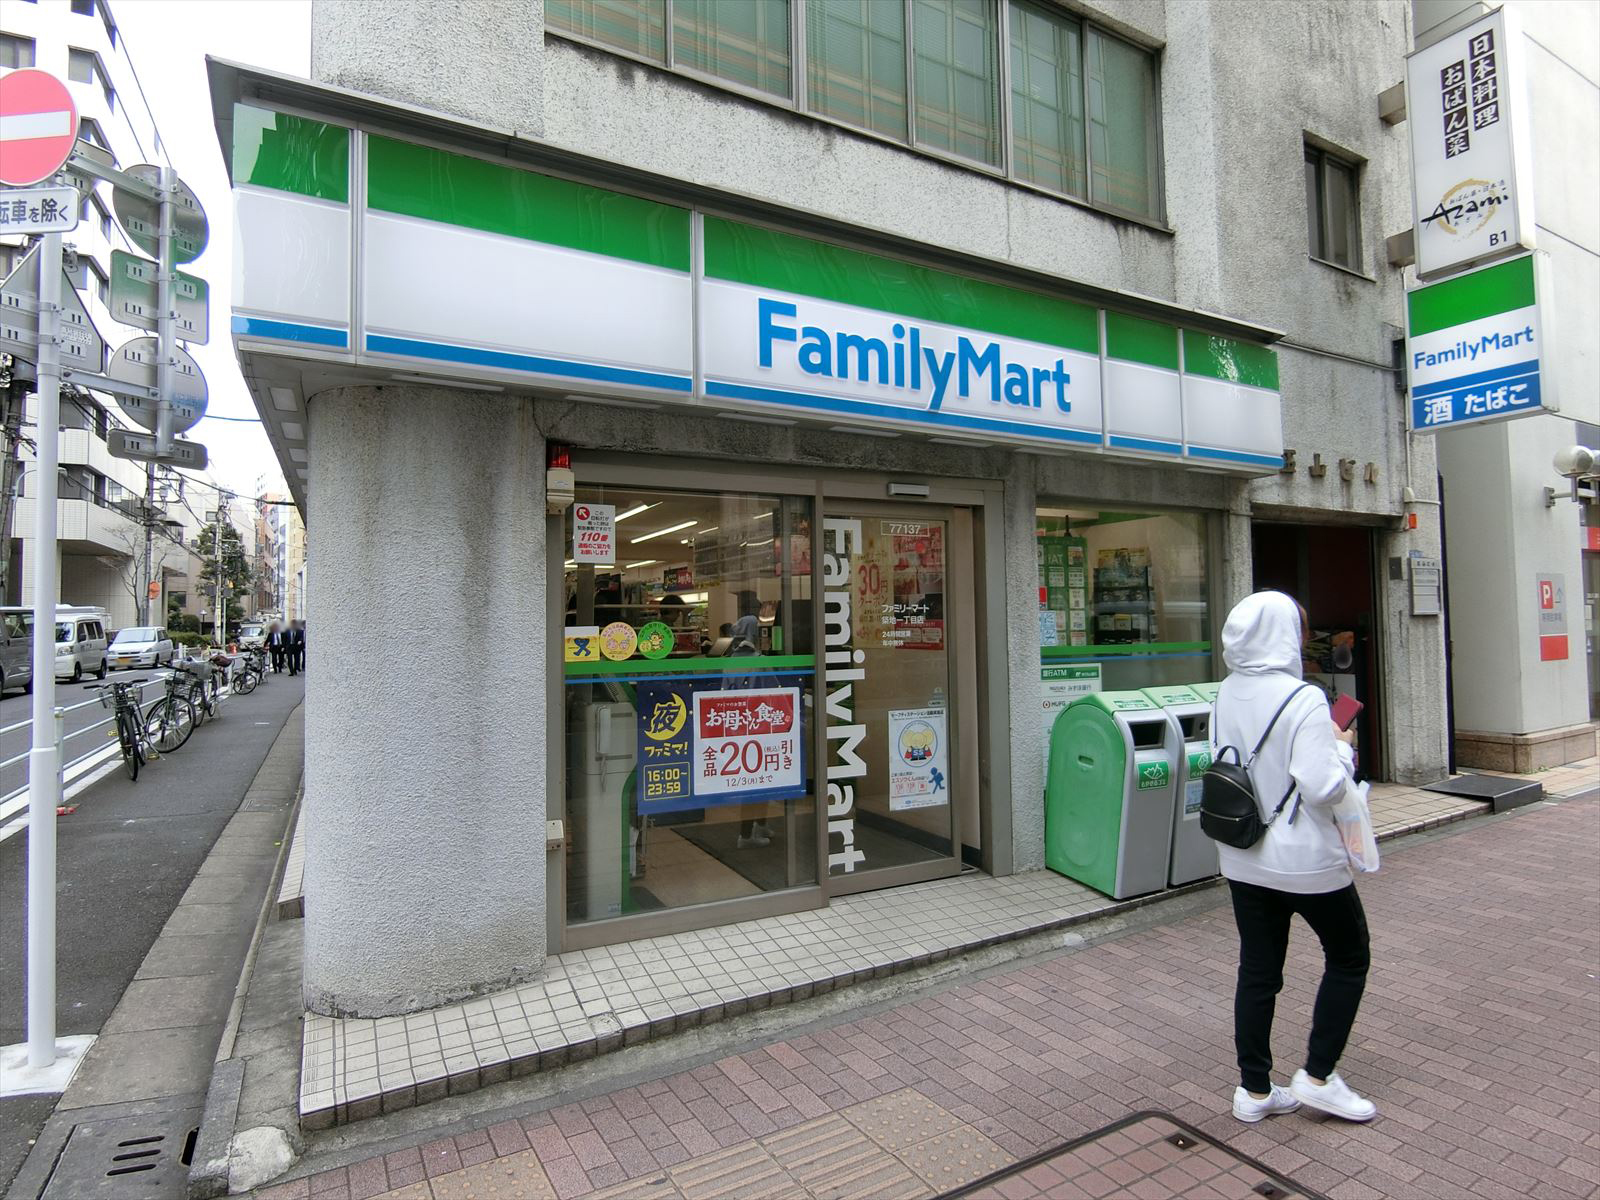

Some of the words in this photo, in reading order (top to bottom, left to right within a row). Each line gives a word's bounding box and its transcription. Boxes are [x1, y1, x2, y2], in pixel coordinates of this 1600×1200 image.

[1471, 31, 1498, 129] 日本料理
[1442, 62, 1468, 157] おばん菜
[1421, 187, 1508, 230] Azami
[1489, 230, 1507, 246] B1
[758, 297, 1071, 412] FamilyMart
[1413, 325, 1534, 370] FamilyMart
[1424, 394, 1453, 425] 酒
[1464, 383, 1530, 415] たばこ
[889, 523, 921, 534] 77137
[881, 604, 930, 613] ファミリーマート
[1542, 585, 1551, 605] P
[881, 615, 925, 625] 築地一丁目店
[823, 519, 867, 873] FamilyMart
[651, 702, 681, 733] 夜
[705, 702, 785, 731] お母さん食堂
[702, 746, 718, 778] 全品
[647, 781, 681, 796] 23:59
